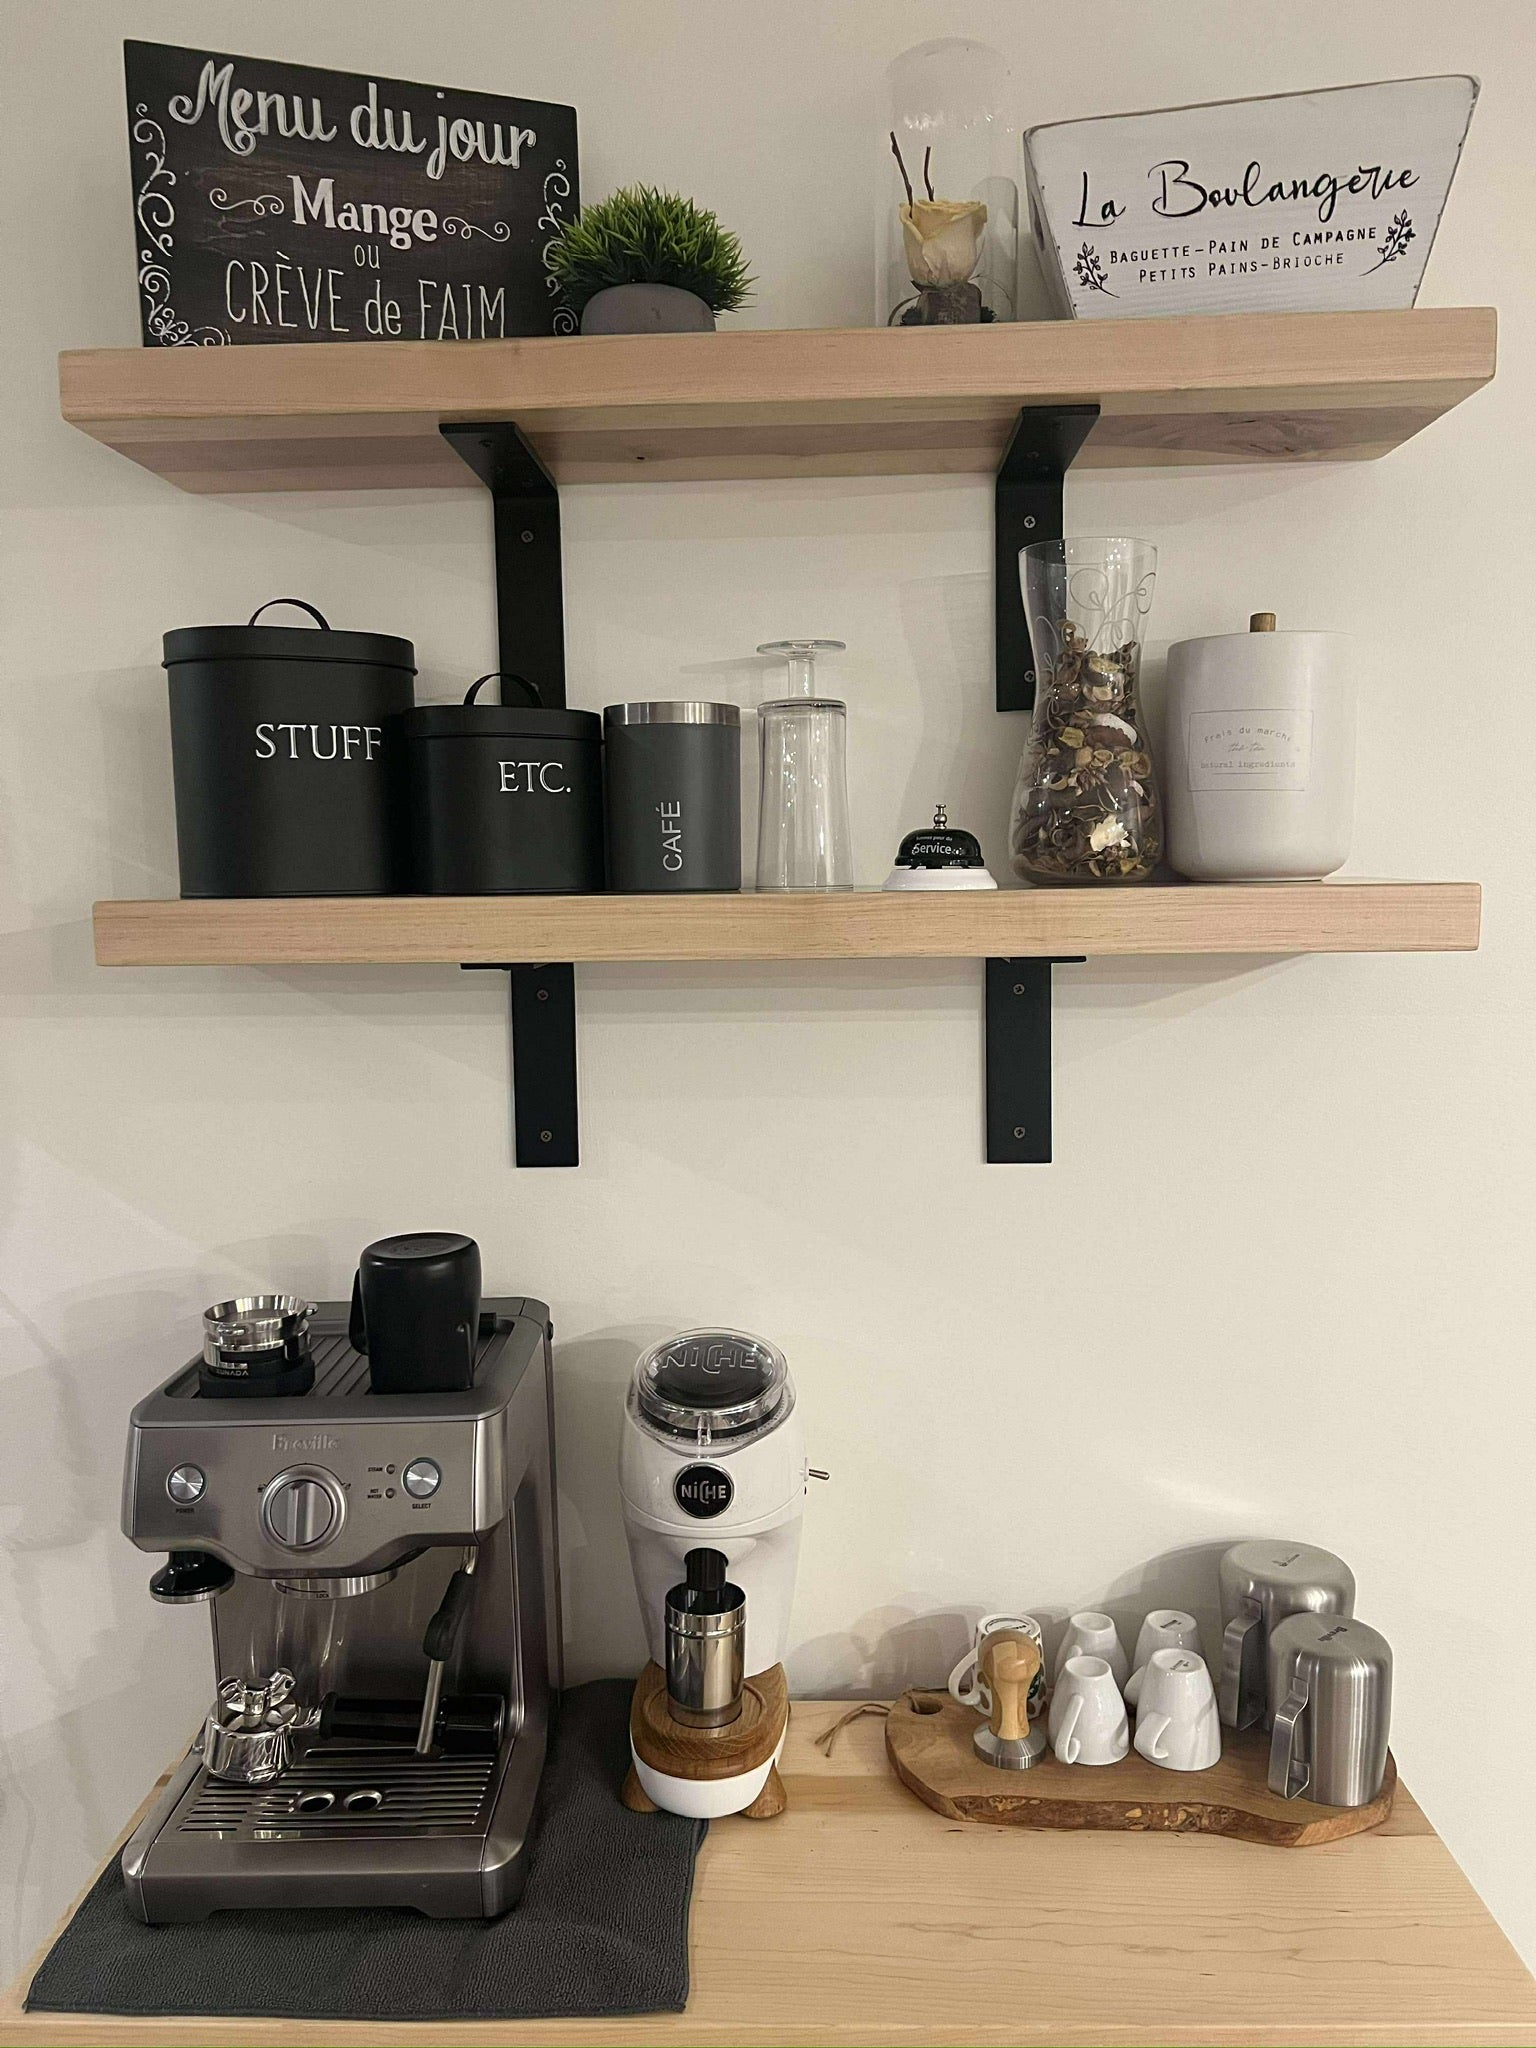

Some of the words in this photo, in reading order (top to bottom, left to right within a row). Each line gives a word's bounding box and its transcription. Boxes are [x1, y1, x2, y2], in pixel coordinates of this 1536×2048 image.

[168, 60, 337, 156] Menu
[350, 82, 427, 154] du
[426, 91, 537, 180] jour
[1072, 171, 1126, 227] La
[1147, 160, 1420, 223] Boulangerie
[287, 175, 438, 250] Mange
[1260, 235, 1281, 250] DE
[1292, 226, 1377, 248] CAMPAGNE
[353, 244, 381, 269] ou
[1139, 265, 1196, 283] PETITS
[225, 250, 349, 333] CRÈVE
[364, 279, 402, 336] de
[418, 279, 505, 341] FAIM
[255, 723, 382, 761] STUFF
[1239, 727, 1251, 735] du
[498, 761, 571, 794] ETC.
[655, 801, 683, 872] CAFÉ
[912, 842, 952, 855] Service
